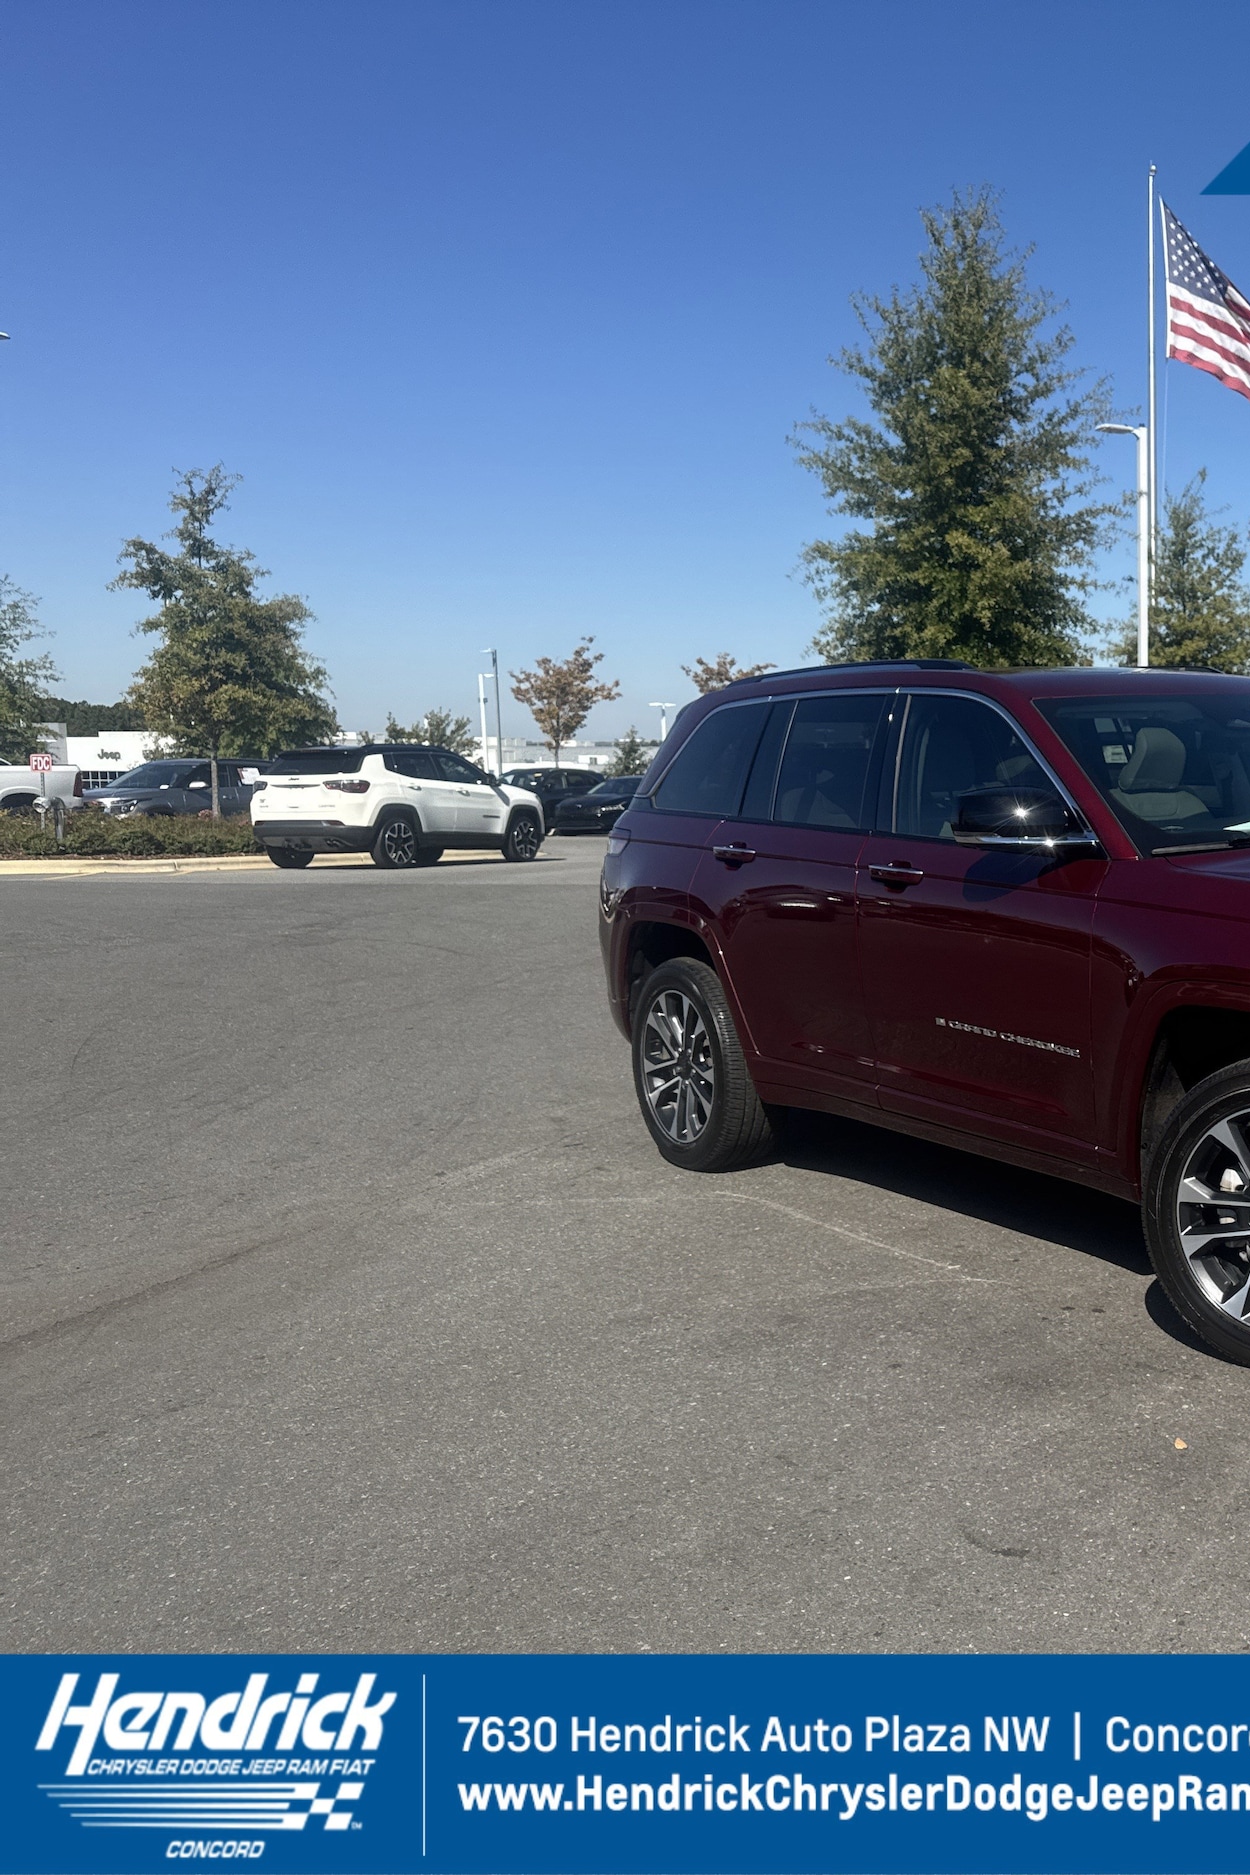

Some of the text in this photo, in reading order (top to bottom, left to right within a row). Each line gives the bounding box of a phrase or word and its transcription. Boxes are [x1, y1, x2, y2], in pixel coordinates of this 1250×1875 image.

[97, 748, 121, 761] Jeep
[32, 756, 50, 770] FDC
[948, 1020, 1081, 1058] GRAND CHEROKEE
